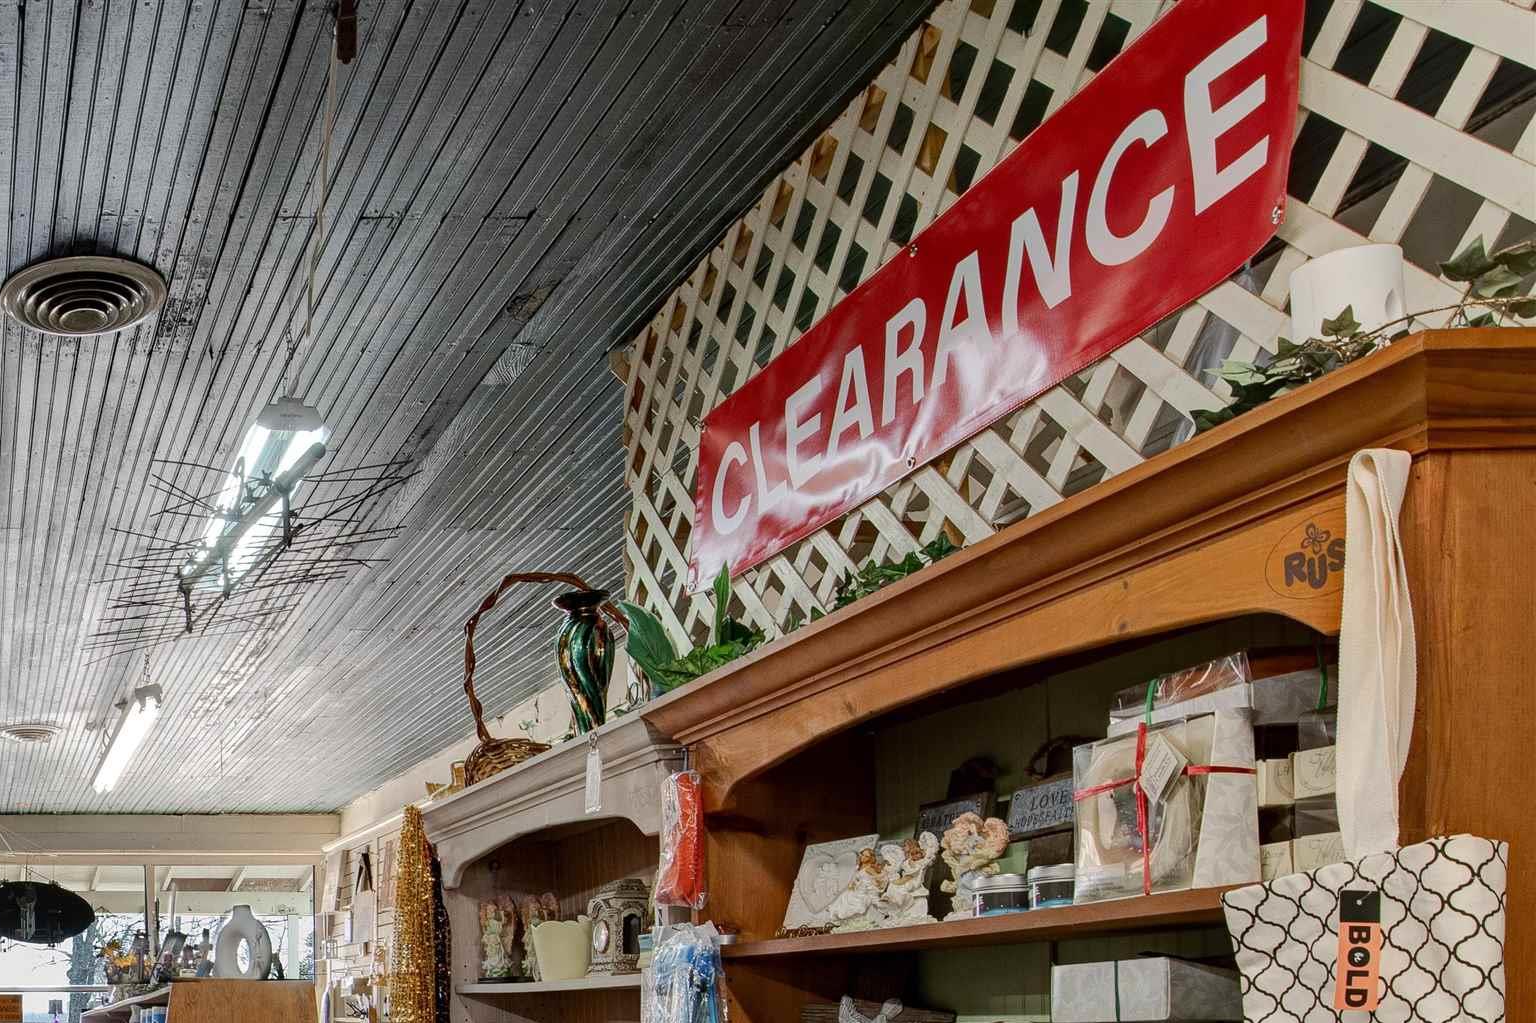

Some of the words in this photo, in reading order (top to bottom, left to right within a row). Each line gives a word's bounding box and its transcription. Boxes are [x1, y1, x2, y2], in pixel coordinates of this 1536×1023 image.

[711, 14, 1268, 536] CLEARANCE
[1284, 538, 1346, 589] RUS
[1344, 924, 1372, 1009] BOLD
